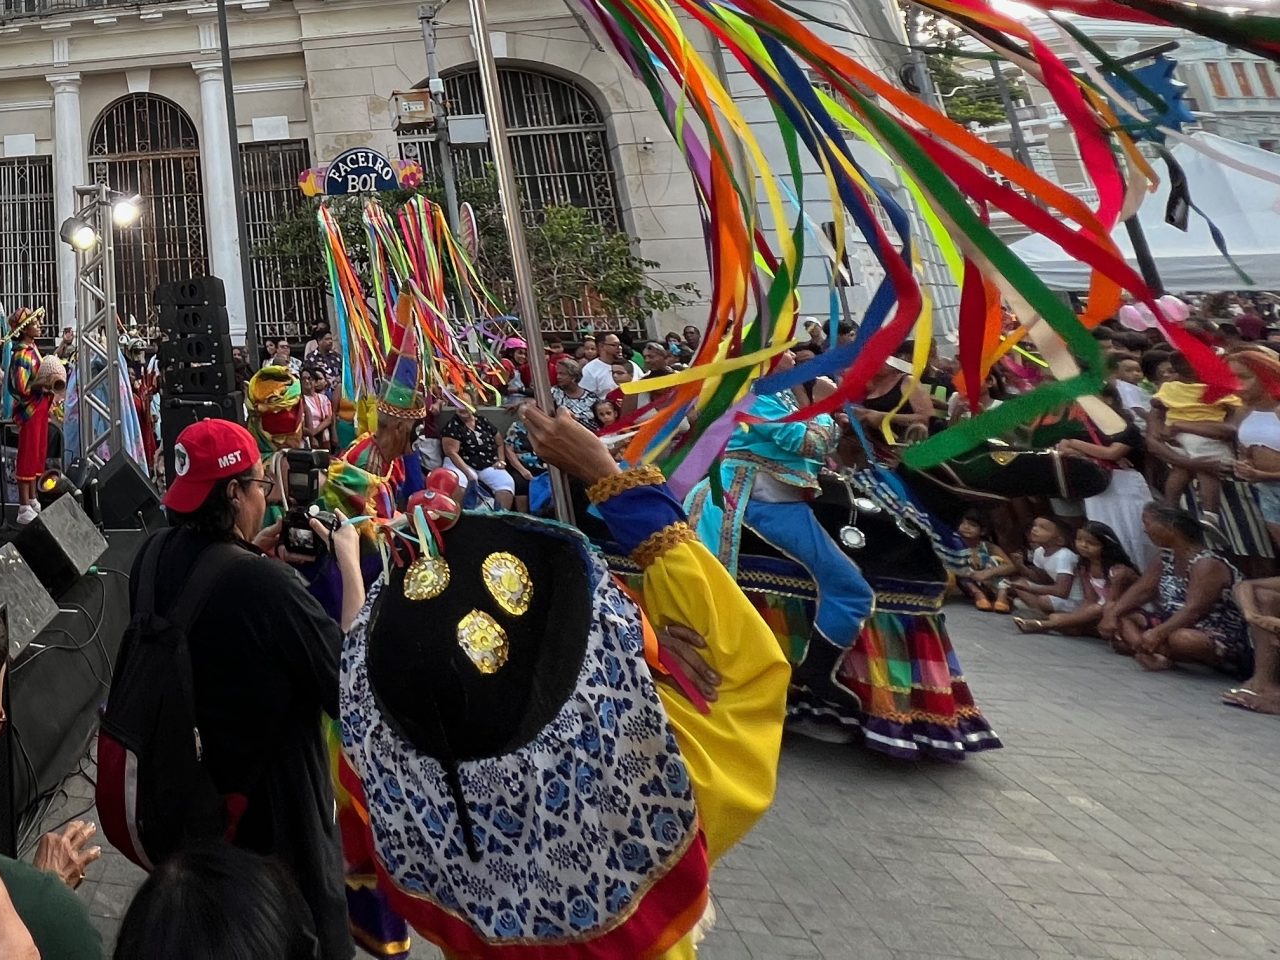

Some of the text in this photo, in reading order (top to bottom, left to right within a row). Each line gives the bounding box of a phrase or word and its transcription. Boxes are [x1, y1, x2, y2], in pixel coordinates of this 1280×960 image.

[329, 152, 393, 183] FACEIRO
[347, 173, 378, 193] BOI
[217, 450, 242, 469] MST
